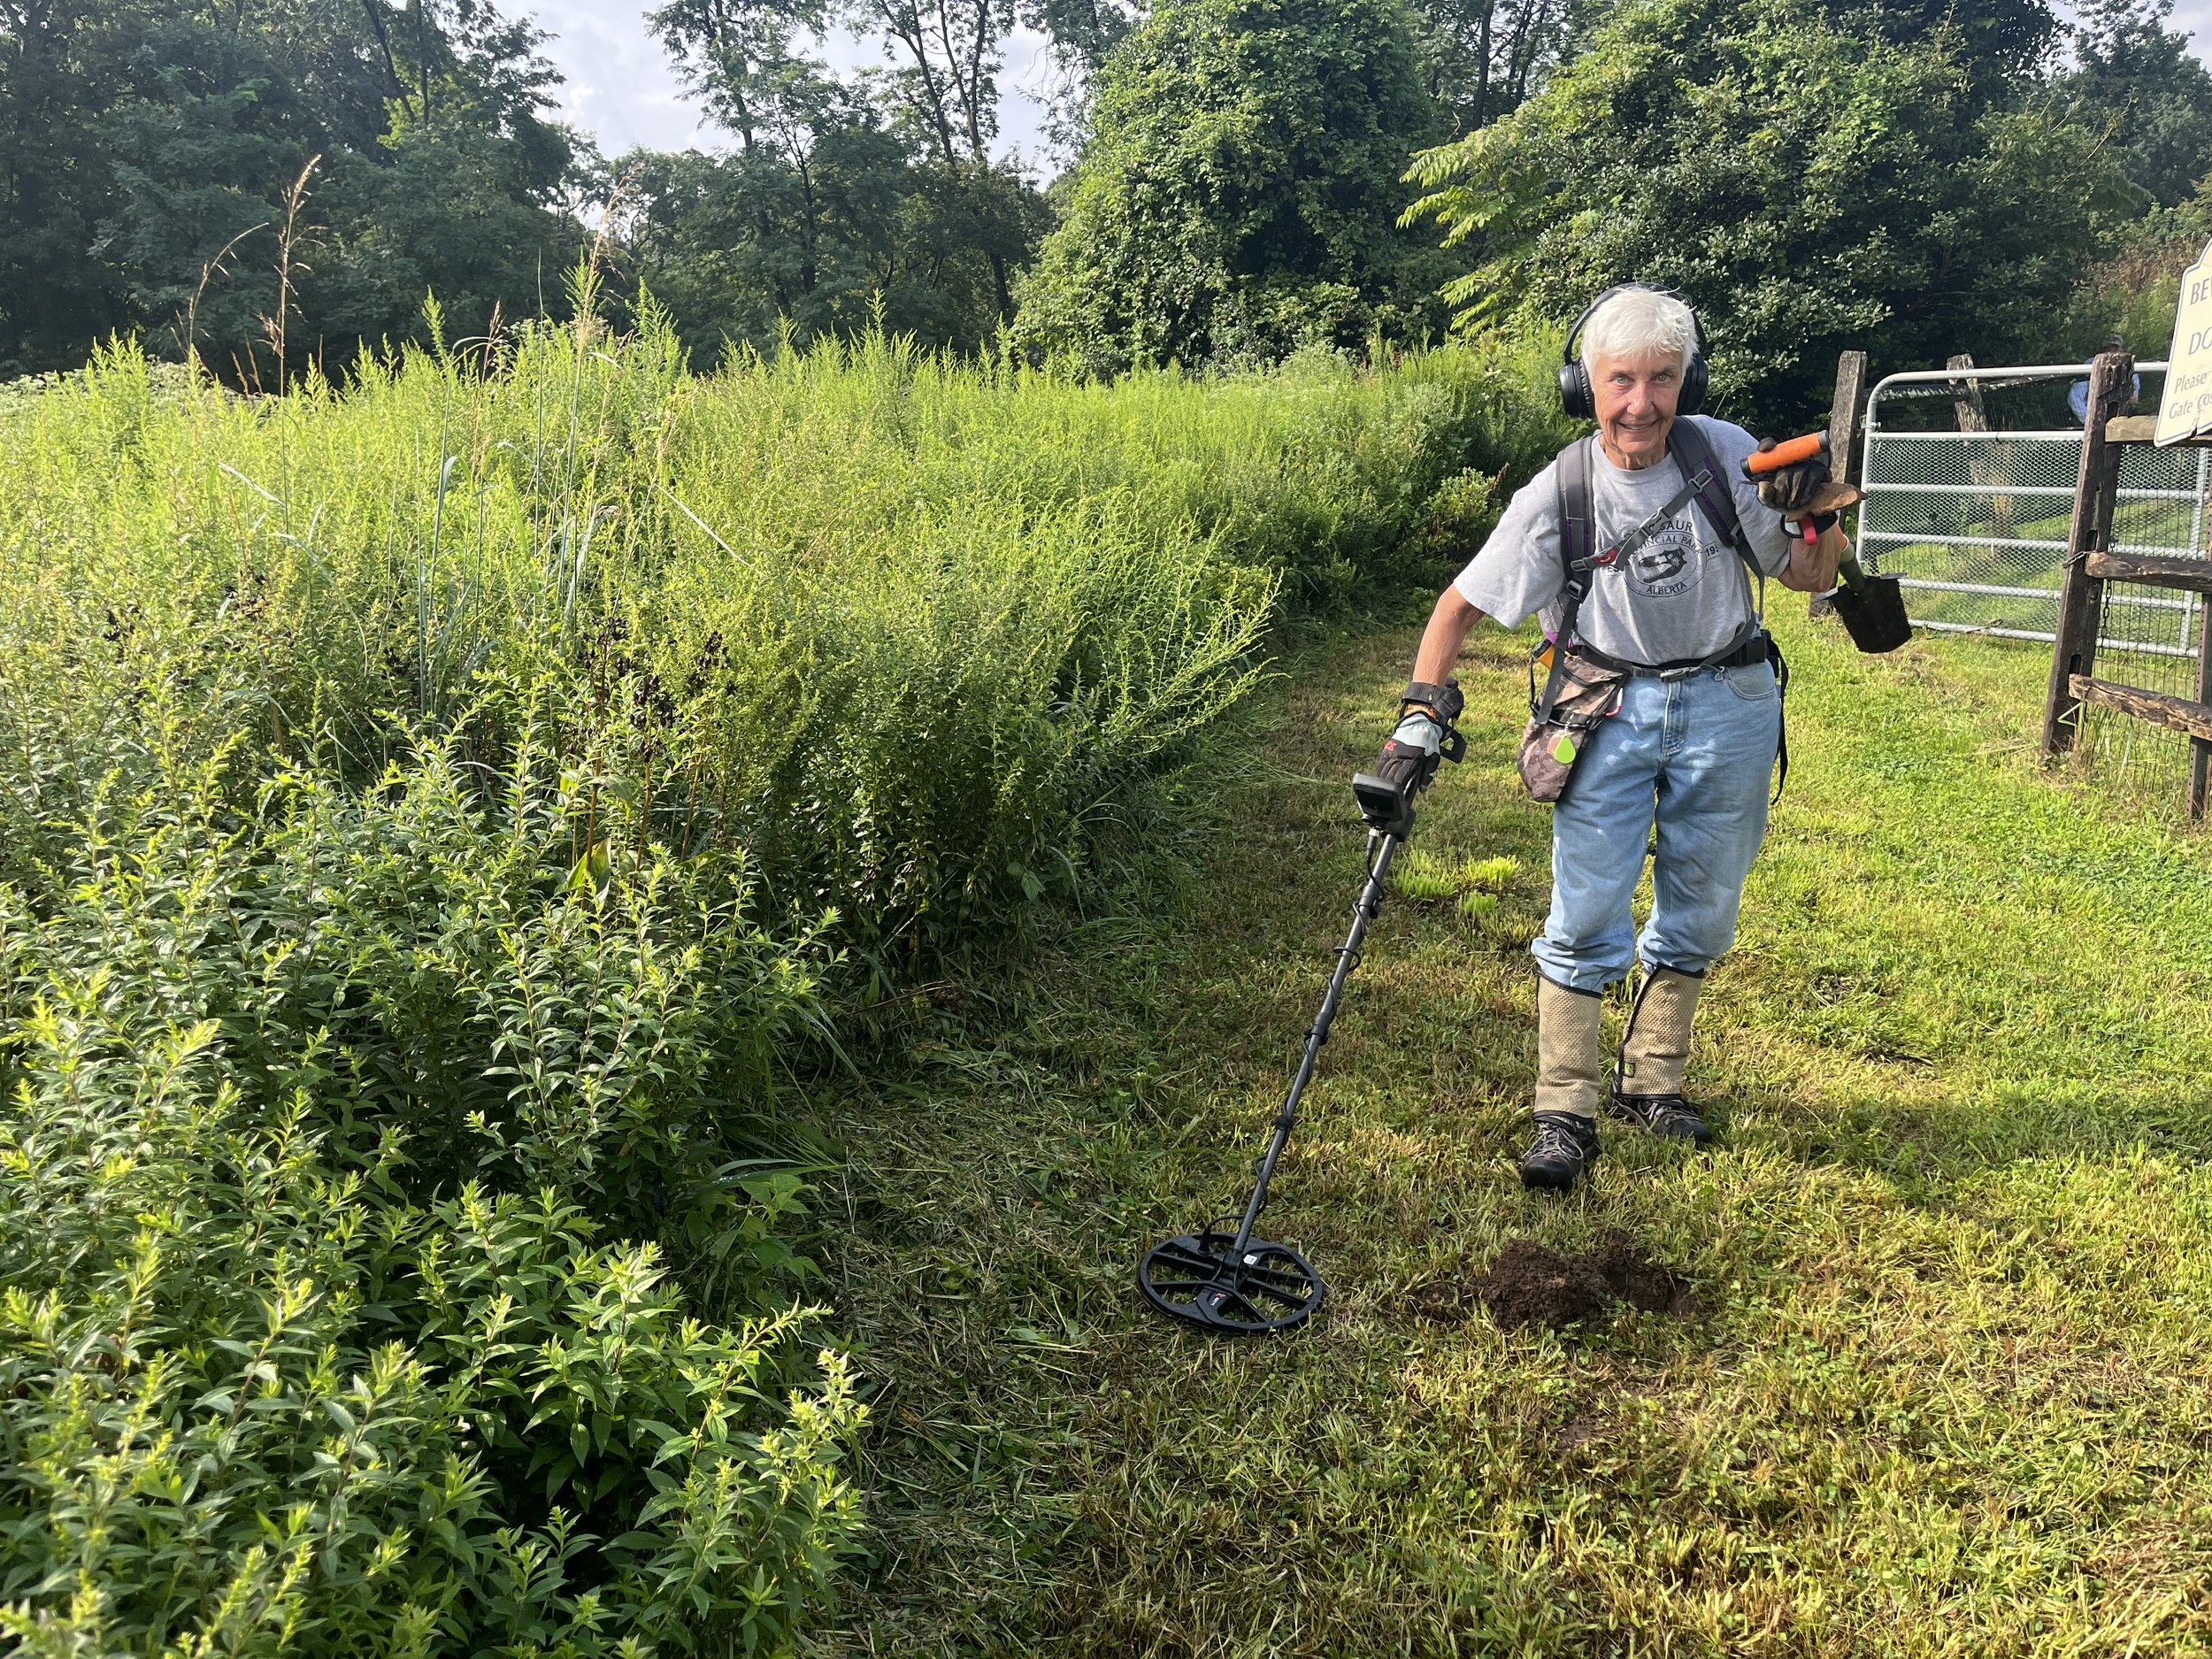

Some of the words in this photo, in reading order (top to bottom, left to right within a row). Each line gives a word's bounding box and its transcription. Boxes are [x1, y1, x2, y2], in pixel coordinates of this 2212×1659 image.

[2189, 277, 2212, 305] BE
[2174, 373, 2208, 394] Please
[2170, 399, 2193, 419] Gate
[1681, 536, 1703, 555] PARK
[1646, 581, 1687, 595] ALBERTA
